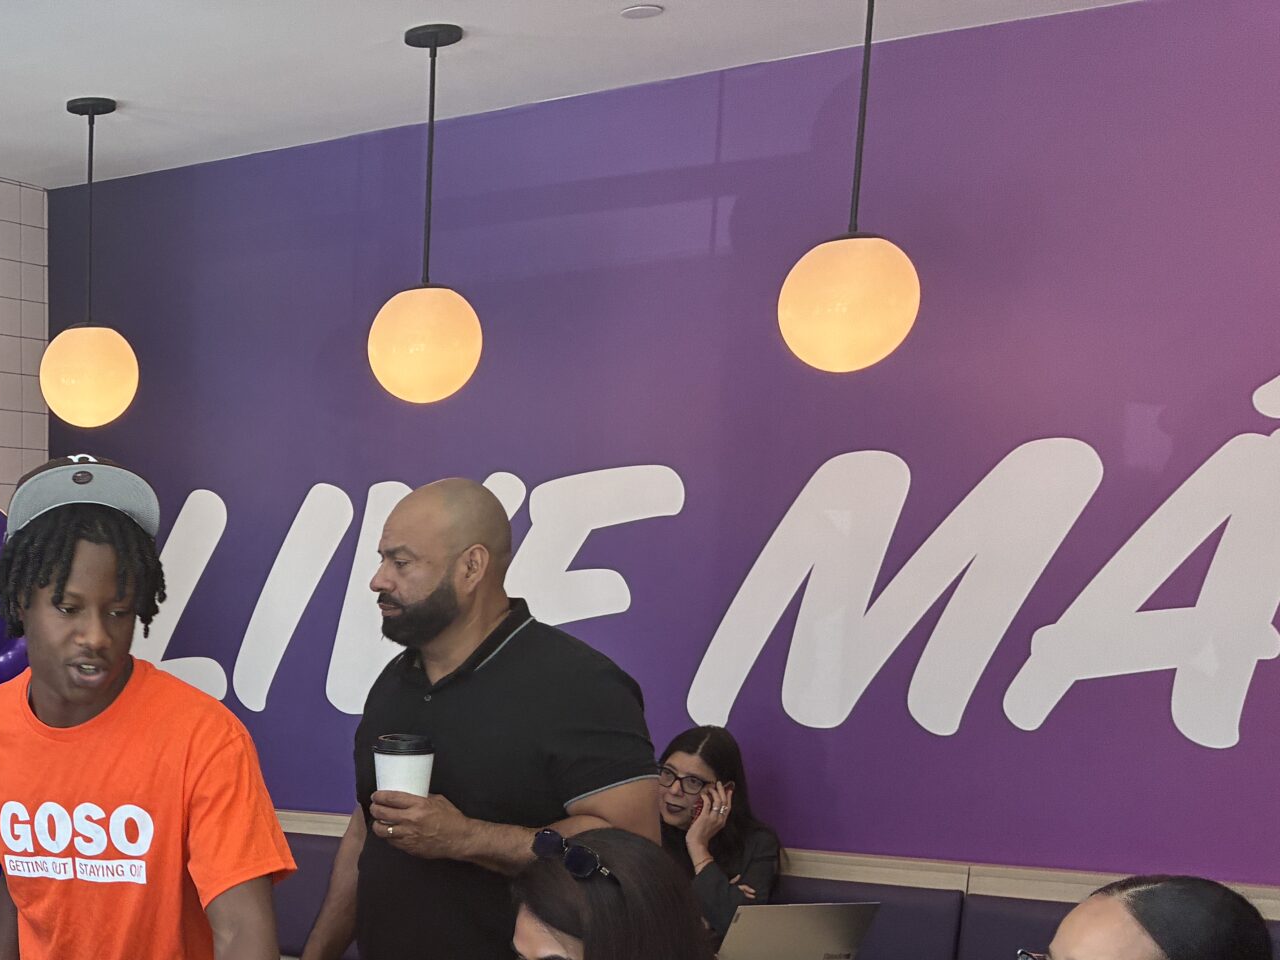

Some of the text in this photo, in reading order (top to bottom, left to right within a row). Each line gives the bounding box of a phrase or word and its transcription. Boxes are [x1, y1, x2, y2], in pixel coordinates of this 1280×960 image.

[0, 800, 154, 856] GOSO
[9, 859, 49, 873] GETTING
[51, 861, 68, 875] OUT
[78, 862, 124, 877] STAYING
